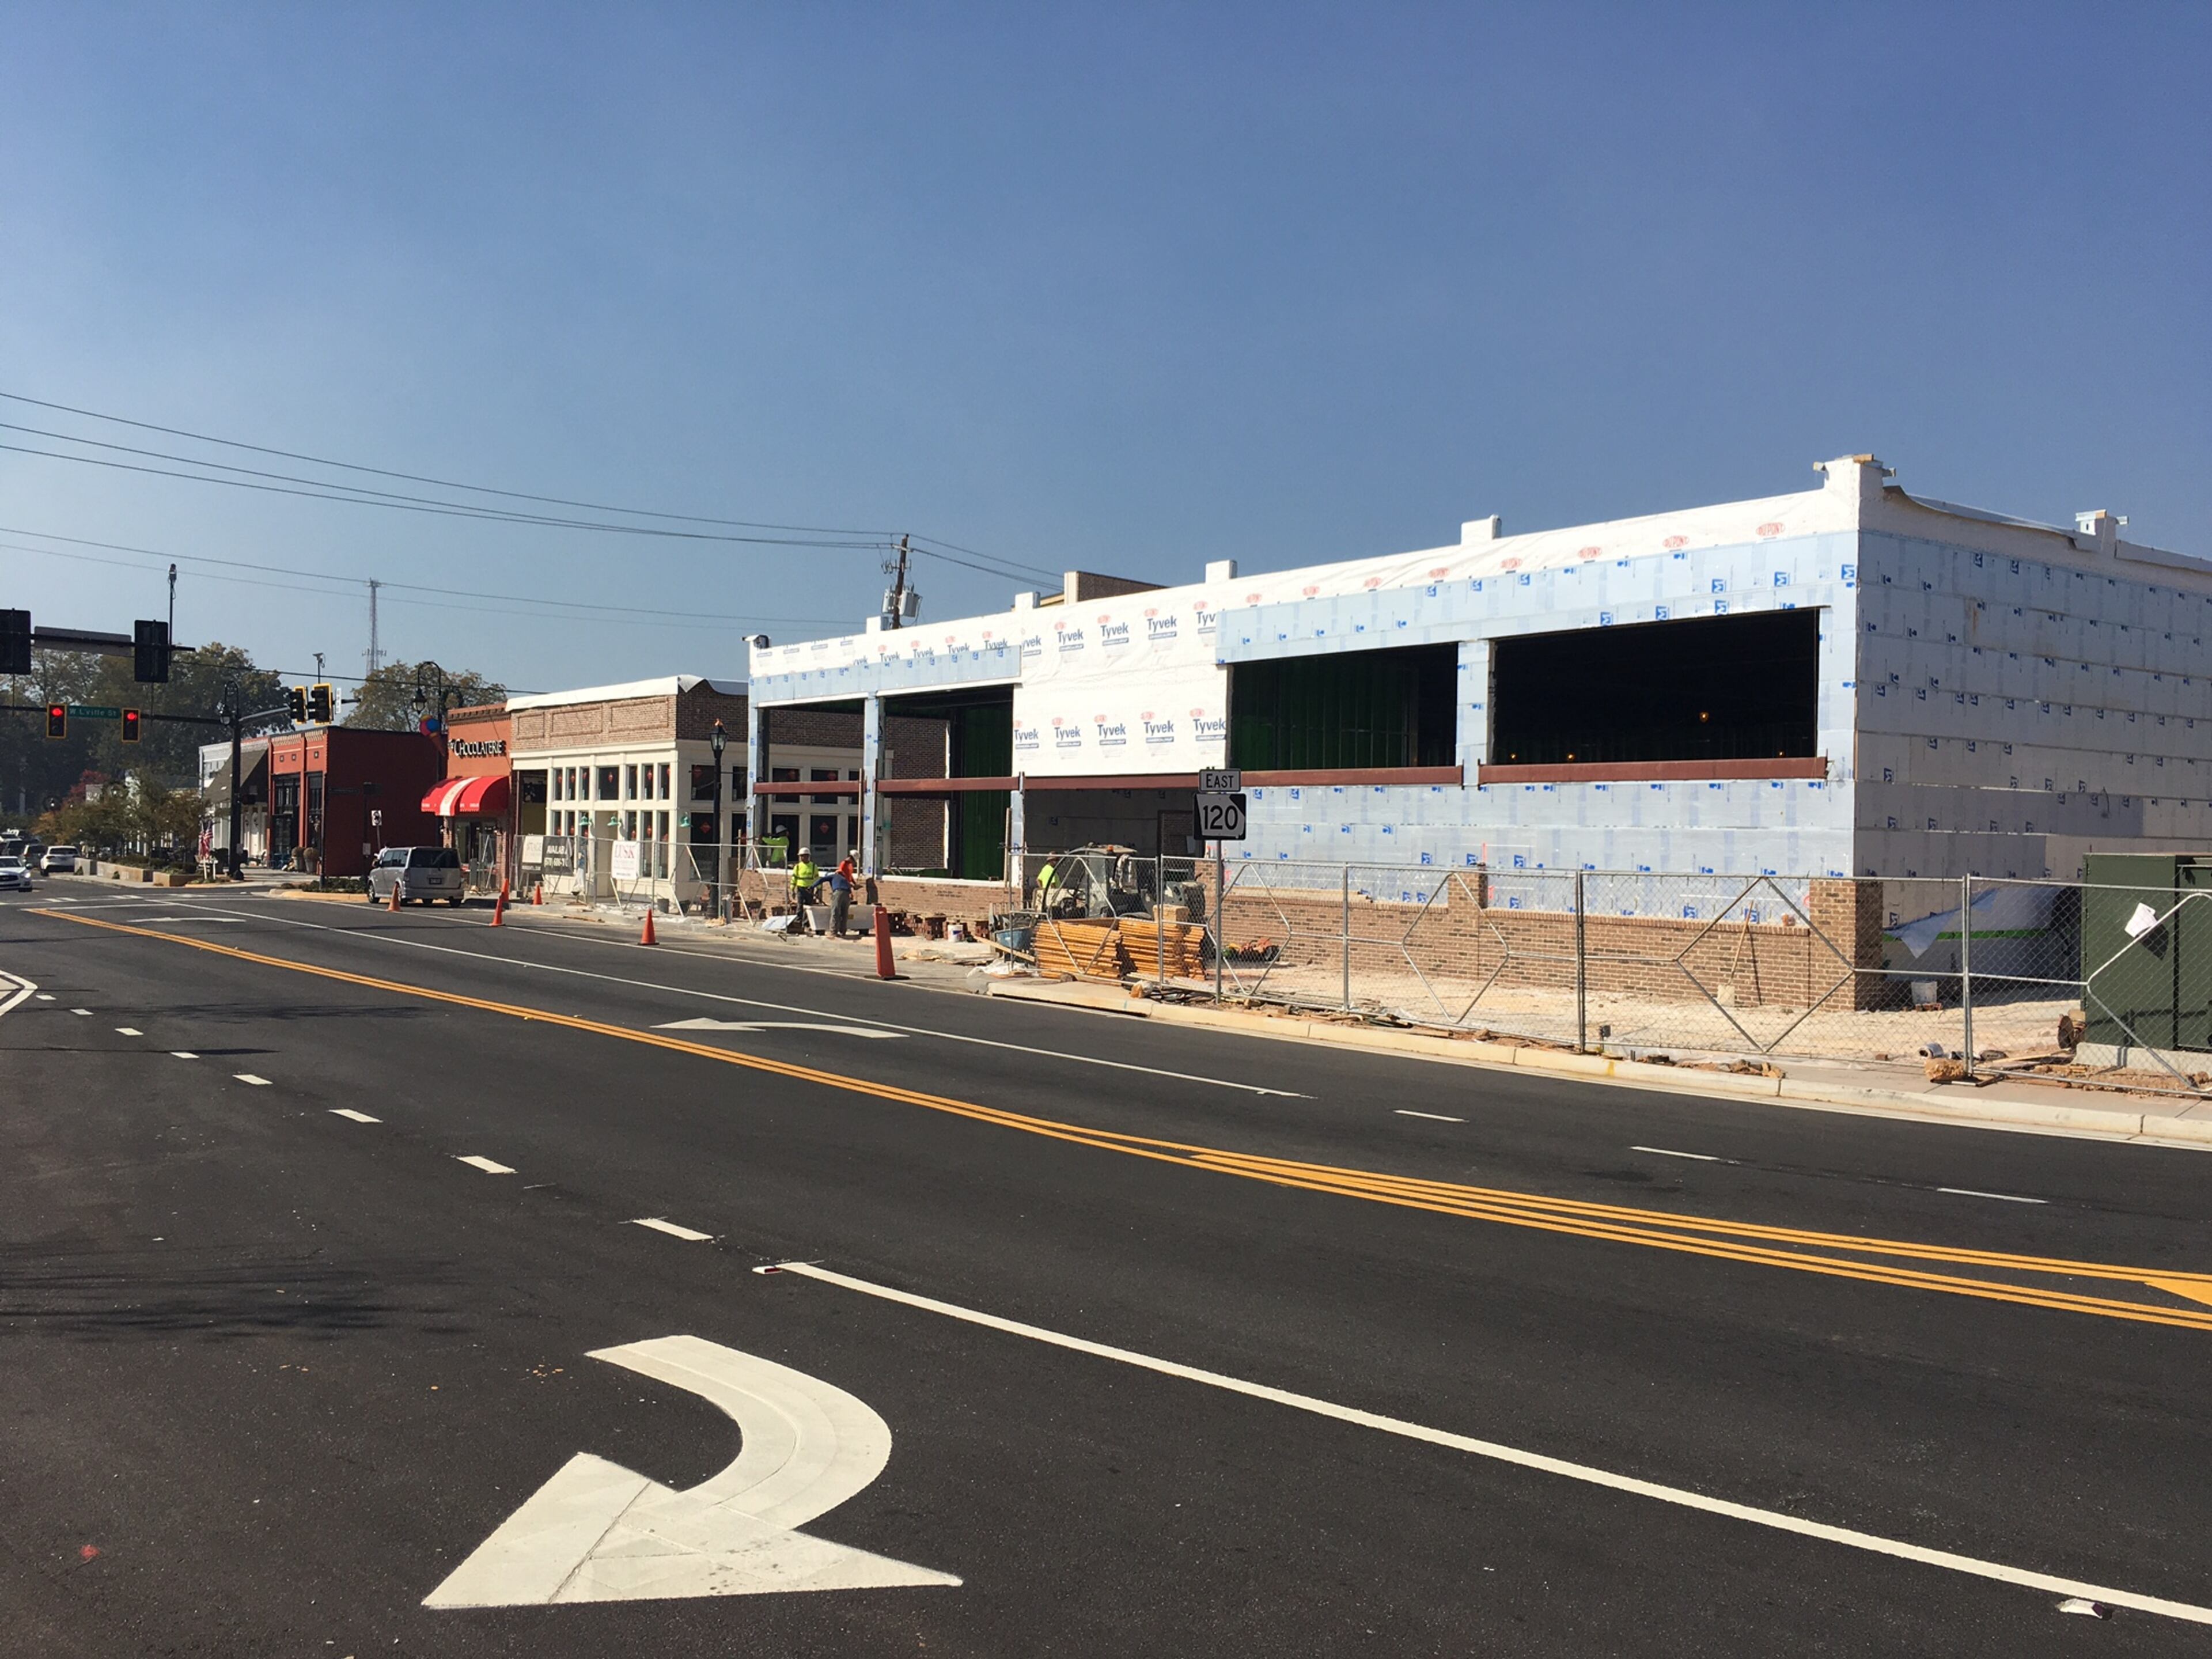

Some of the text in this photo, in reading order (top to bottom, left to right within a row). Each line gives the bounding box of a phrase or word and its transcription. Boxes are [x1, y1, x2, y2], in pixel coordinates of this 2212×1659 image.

[1147, 615, 1177, 632] Tyvek
[1196, 611, 1216, 626] Tyv
[1057, 628, 1084, 645] Tyvek
[1100, 622, 1128, 638] Tyvek
[1054, 726, 1081, 741] Tyvek
[1097, 723, 1126, 738] Tyvek
[1144, 720, 1174, 736] Tyvek
[1193, 718, 1226, 734] Tyvek
[1014, 728, 1039, 742] Tyvek
[1206, 773, 1234, 788] EAST
[1203, 805, 1238, 830] 120
